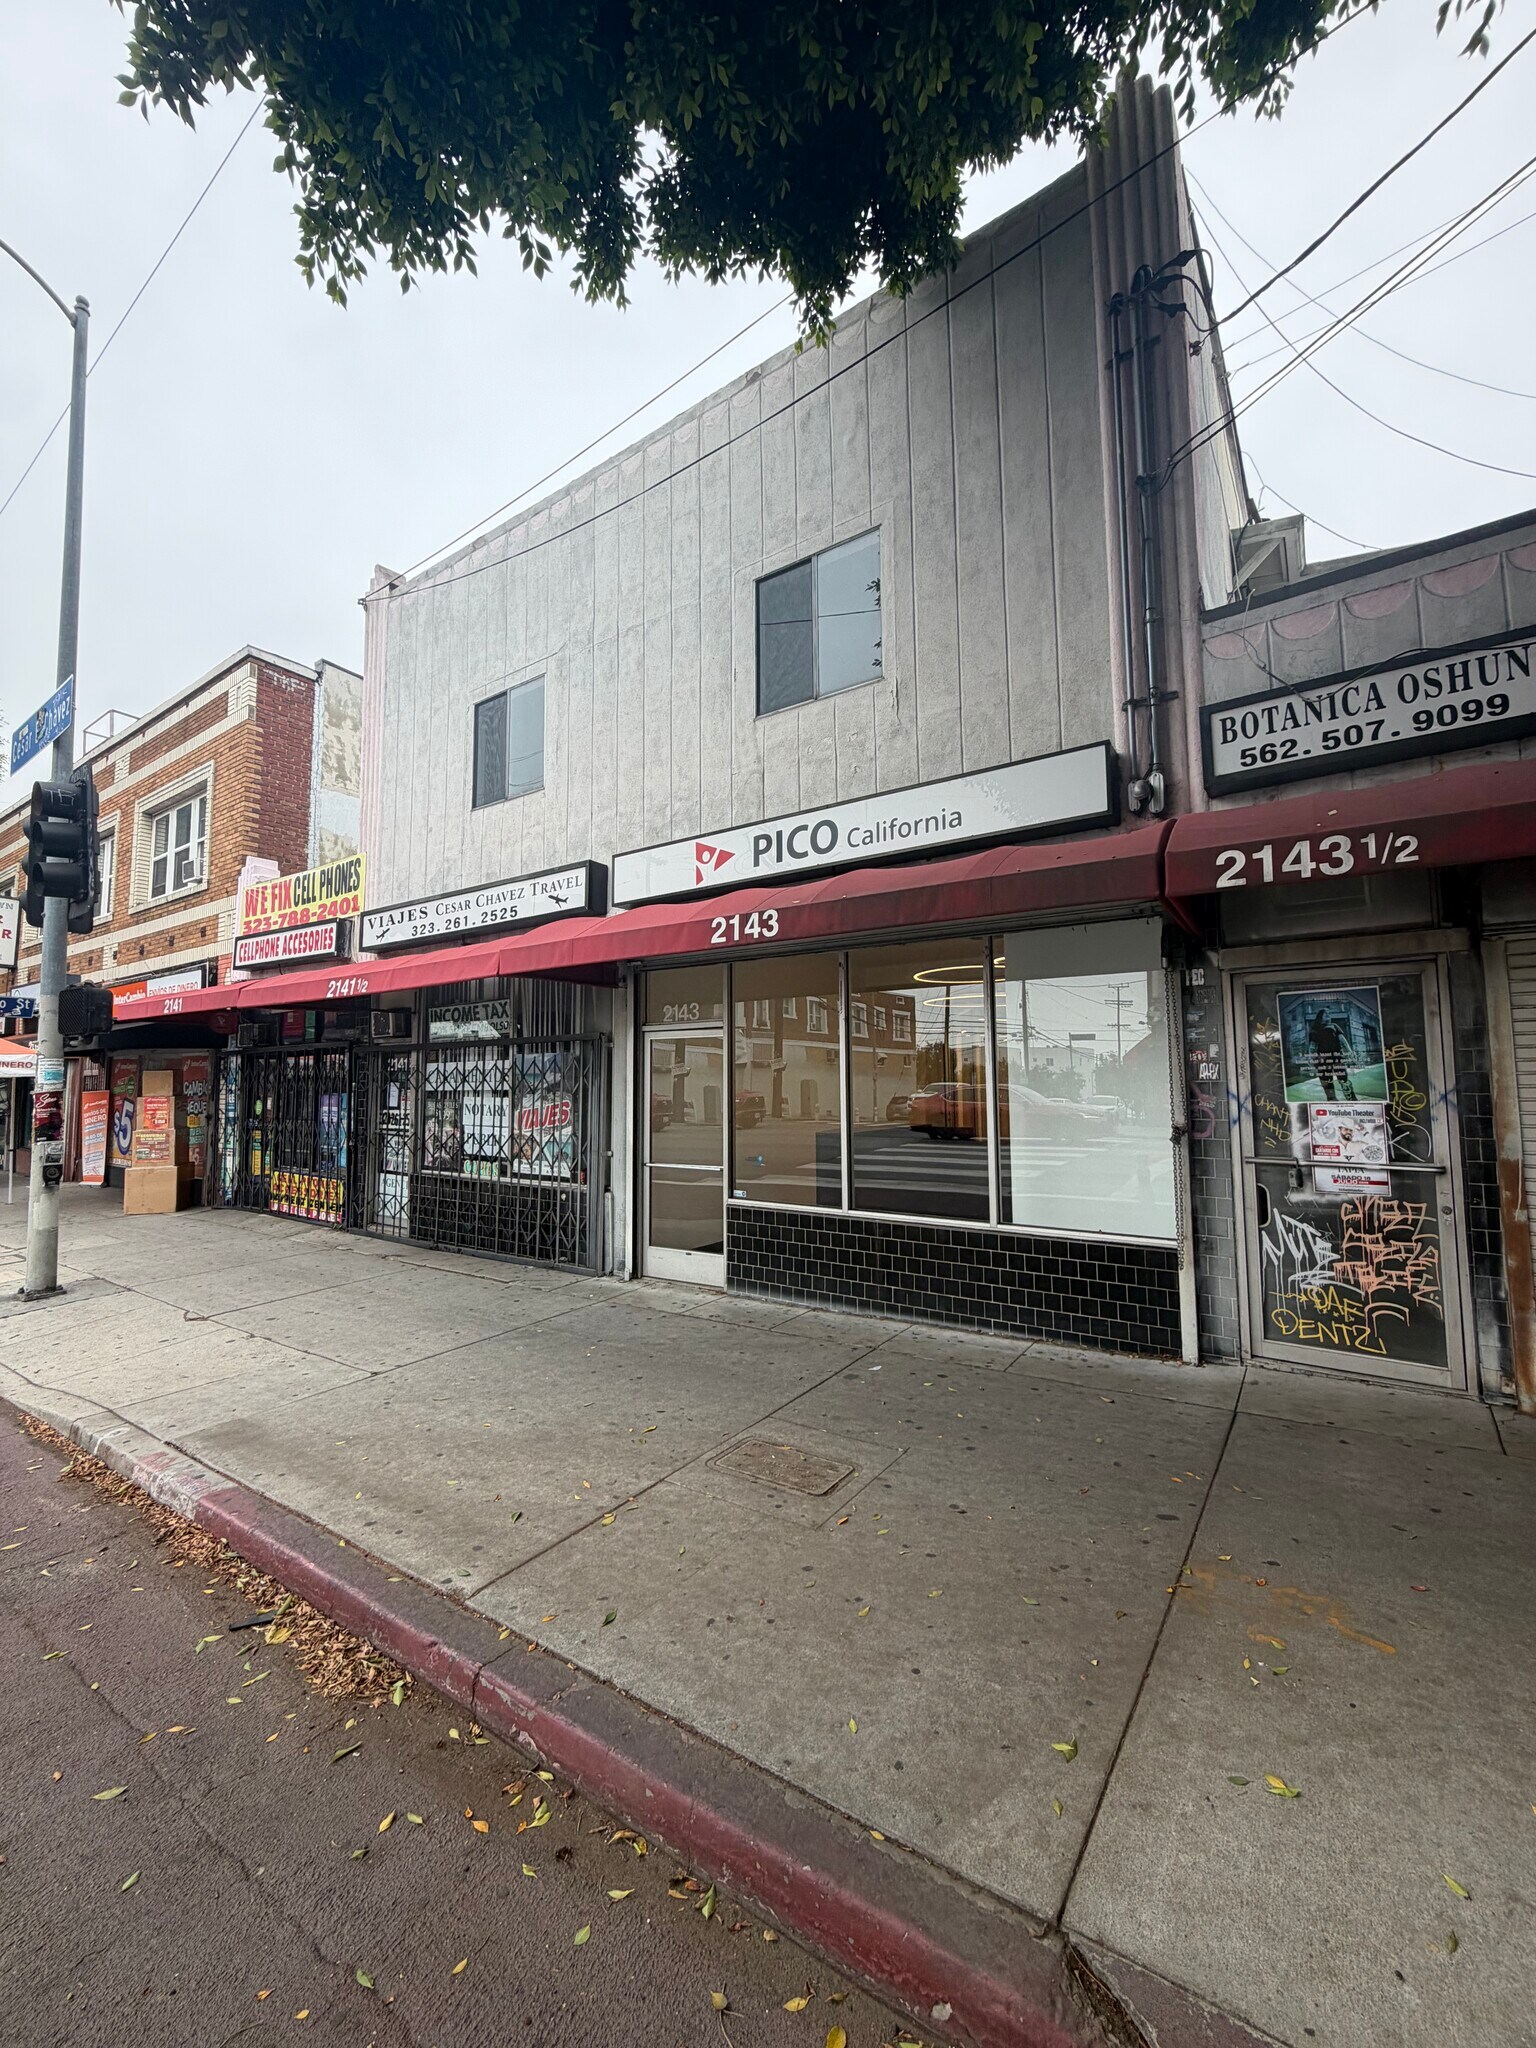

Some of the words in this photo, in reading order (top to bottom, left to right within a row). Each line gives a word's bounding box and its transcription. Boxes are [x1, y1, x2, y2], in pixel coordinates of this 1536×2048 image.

[1220, 682, 1387, 744] BOTANICA
[1397, 645, 1532, 703] OSHUN
[12, 731, 33, 763] Cesar
[752, 818, 839, 868] PICO
[846, 807, 963, 849] California
[1214, 834, 1356, 889] 2143
[245, 885, 269, 918] WE
[270, 879, 293, 913] FIX
[293, 873, 317, 908] CELL
[319, 857, 361, 901] PHONES
[243, 894, 361, 935] 323-788-2401
[367, 906, 429, 930] VIAJES
[710, 909, 780, 944] 2143
[239, 936, 280, 962] CELLPHONE
[281, 926, 334, 956] ACCESORIES
[326, 977, 356, 998] 2141
[16, 998, 31, 1010] St
[163, 998, 182, 1013] 2141
[430, 1005, 481, 1023] INCOME
[482, 1001, 510, 1020] TAX
[663, 1002, 700, 1022] 2143
[464, 1103, 509, 1117] NOTARY
[515, 1099, 570, 1132] VIAJES
[1327, 1109, 1352, 1117] YouTube
[1352, 1109, 1375, 1117] Theater
